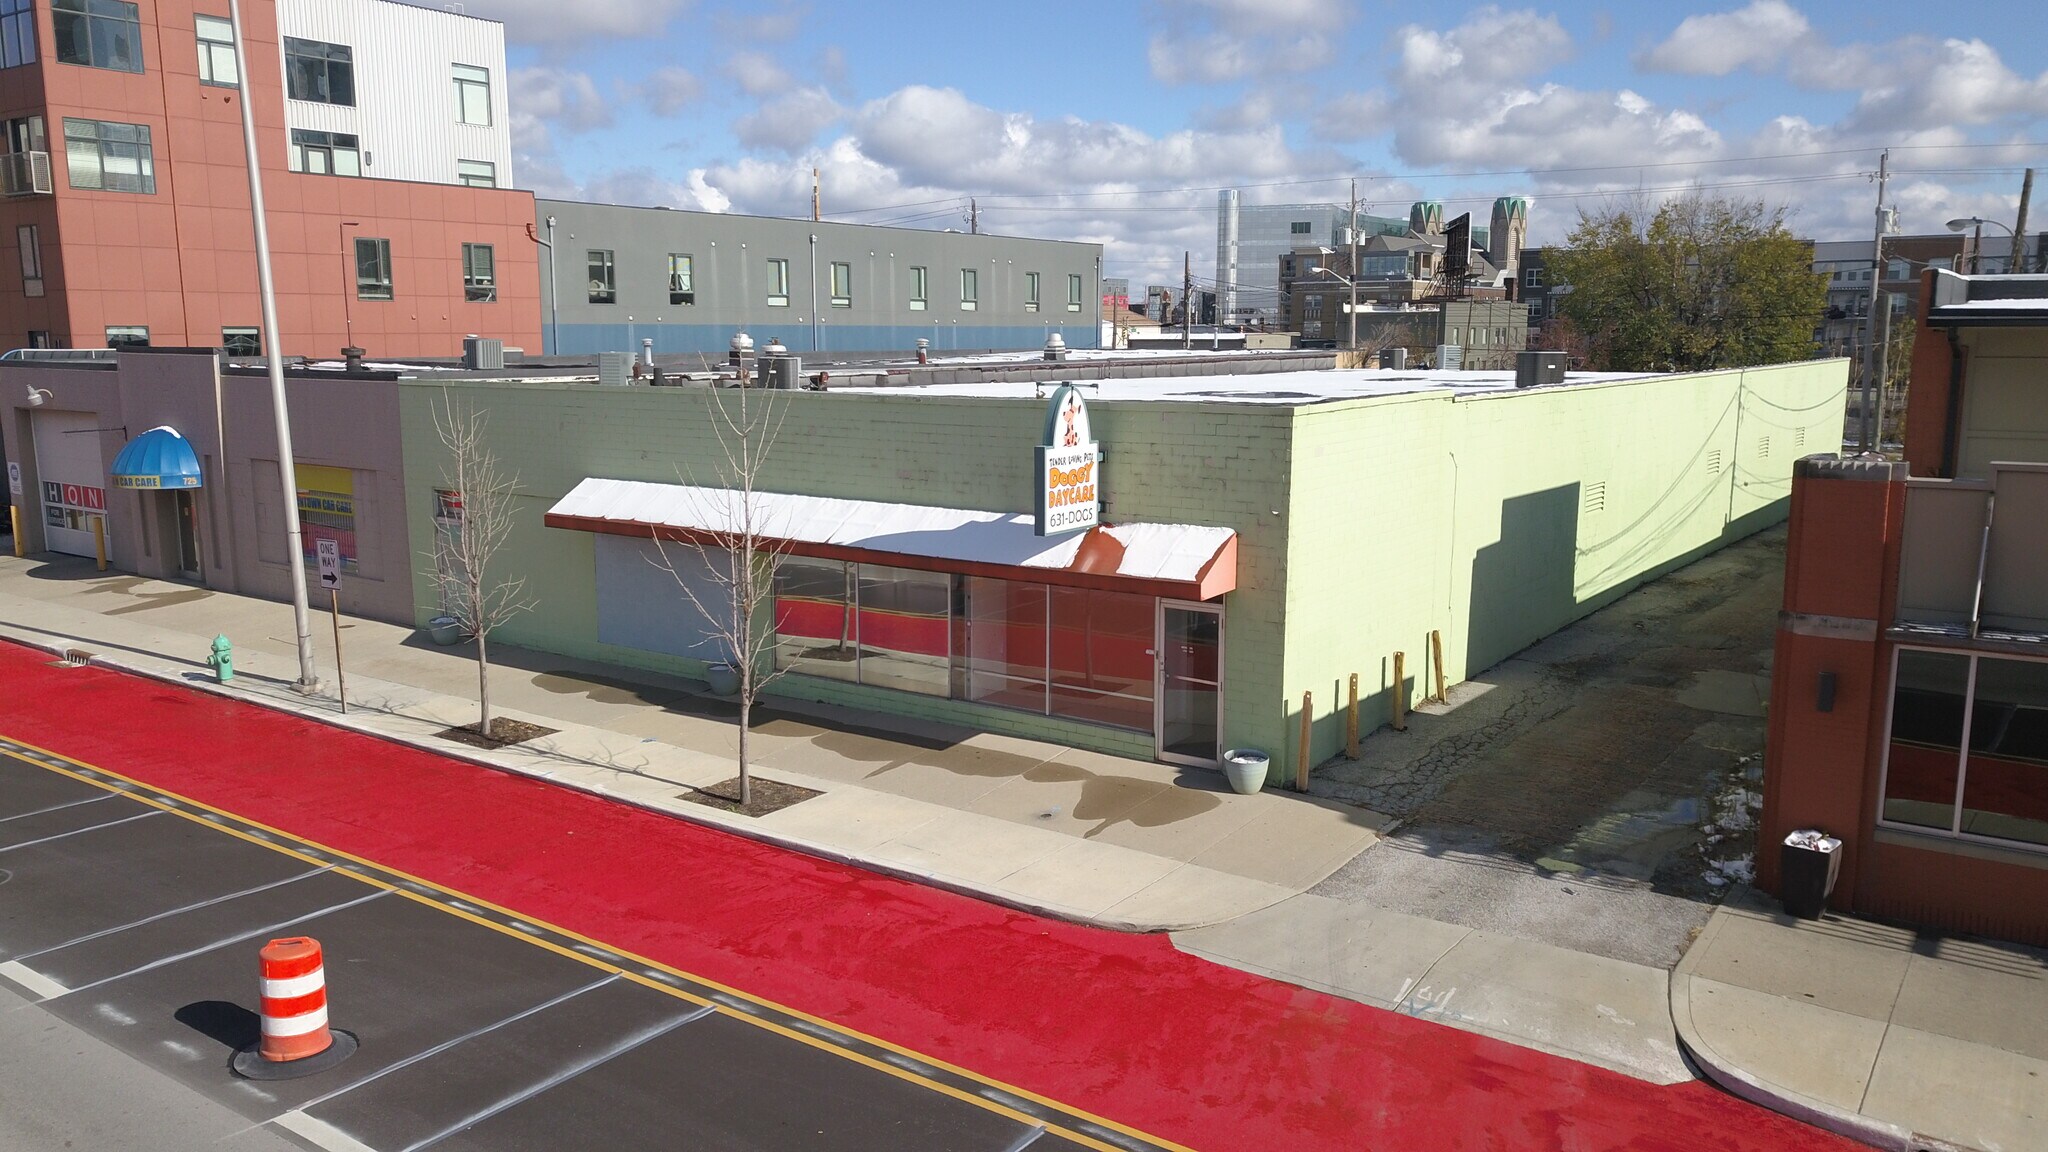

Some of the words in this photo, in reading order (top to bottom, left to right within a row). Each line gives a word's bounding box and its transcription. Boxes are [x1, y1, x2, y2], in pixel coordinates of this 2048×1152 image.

[1049, 460, 1094, 489] DOGGY
[120, 477, 133, 487] CAR
[135, 477, 158, 487] CARE
[182, 477, 198, 486] 725
[1048, 484, 1094, 509] DAYCARE
[322, 498, 336, 511] CAR
[1050, 507, 1093, 527] 631-DOGS
[320, 543, 335, 555] ONE
[321, 557, 336, 568] WAY
